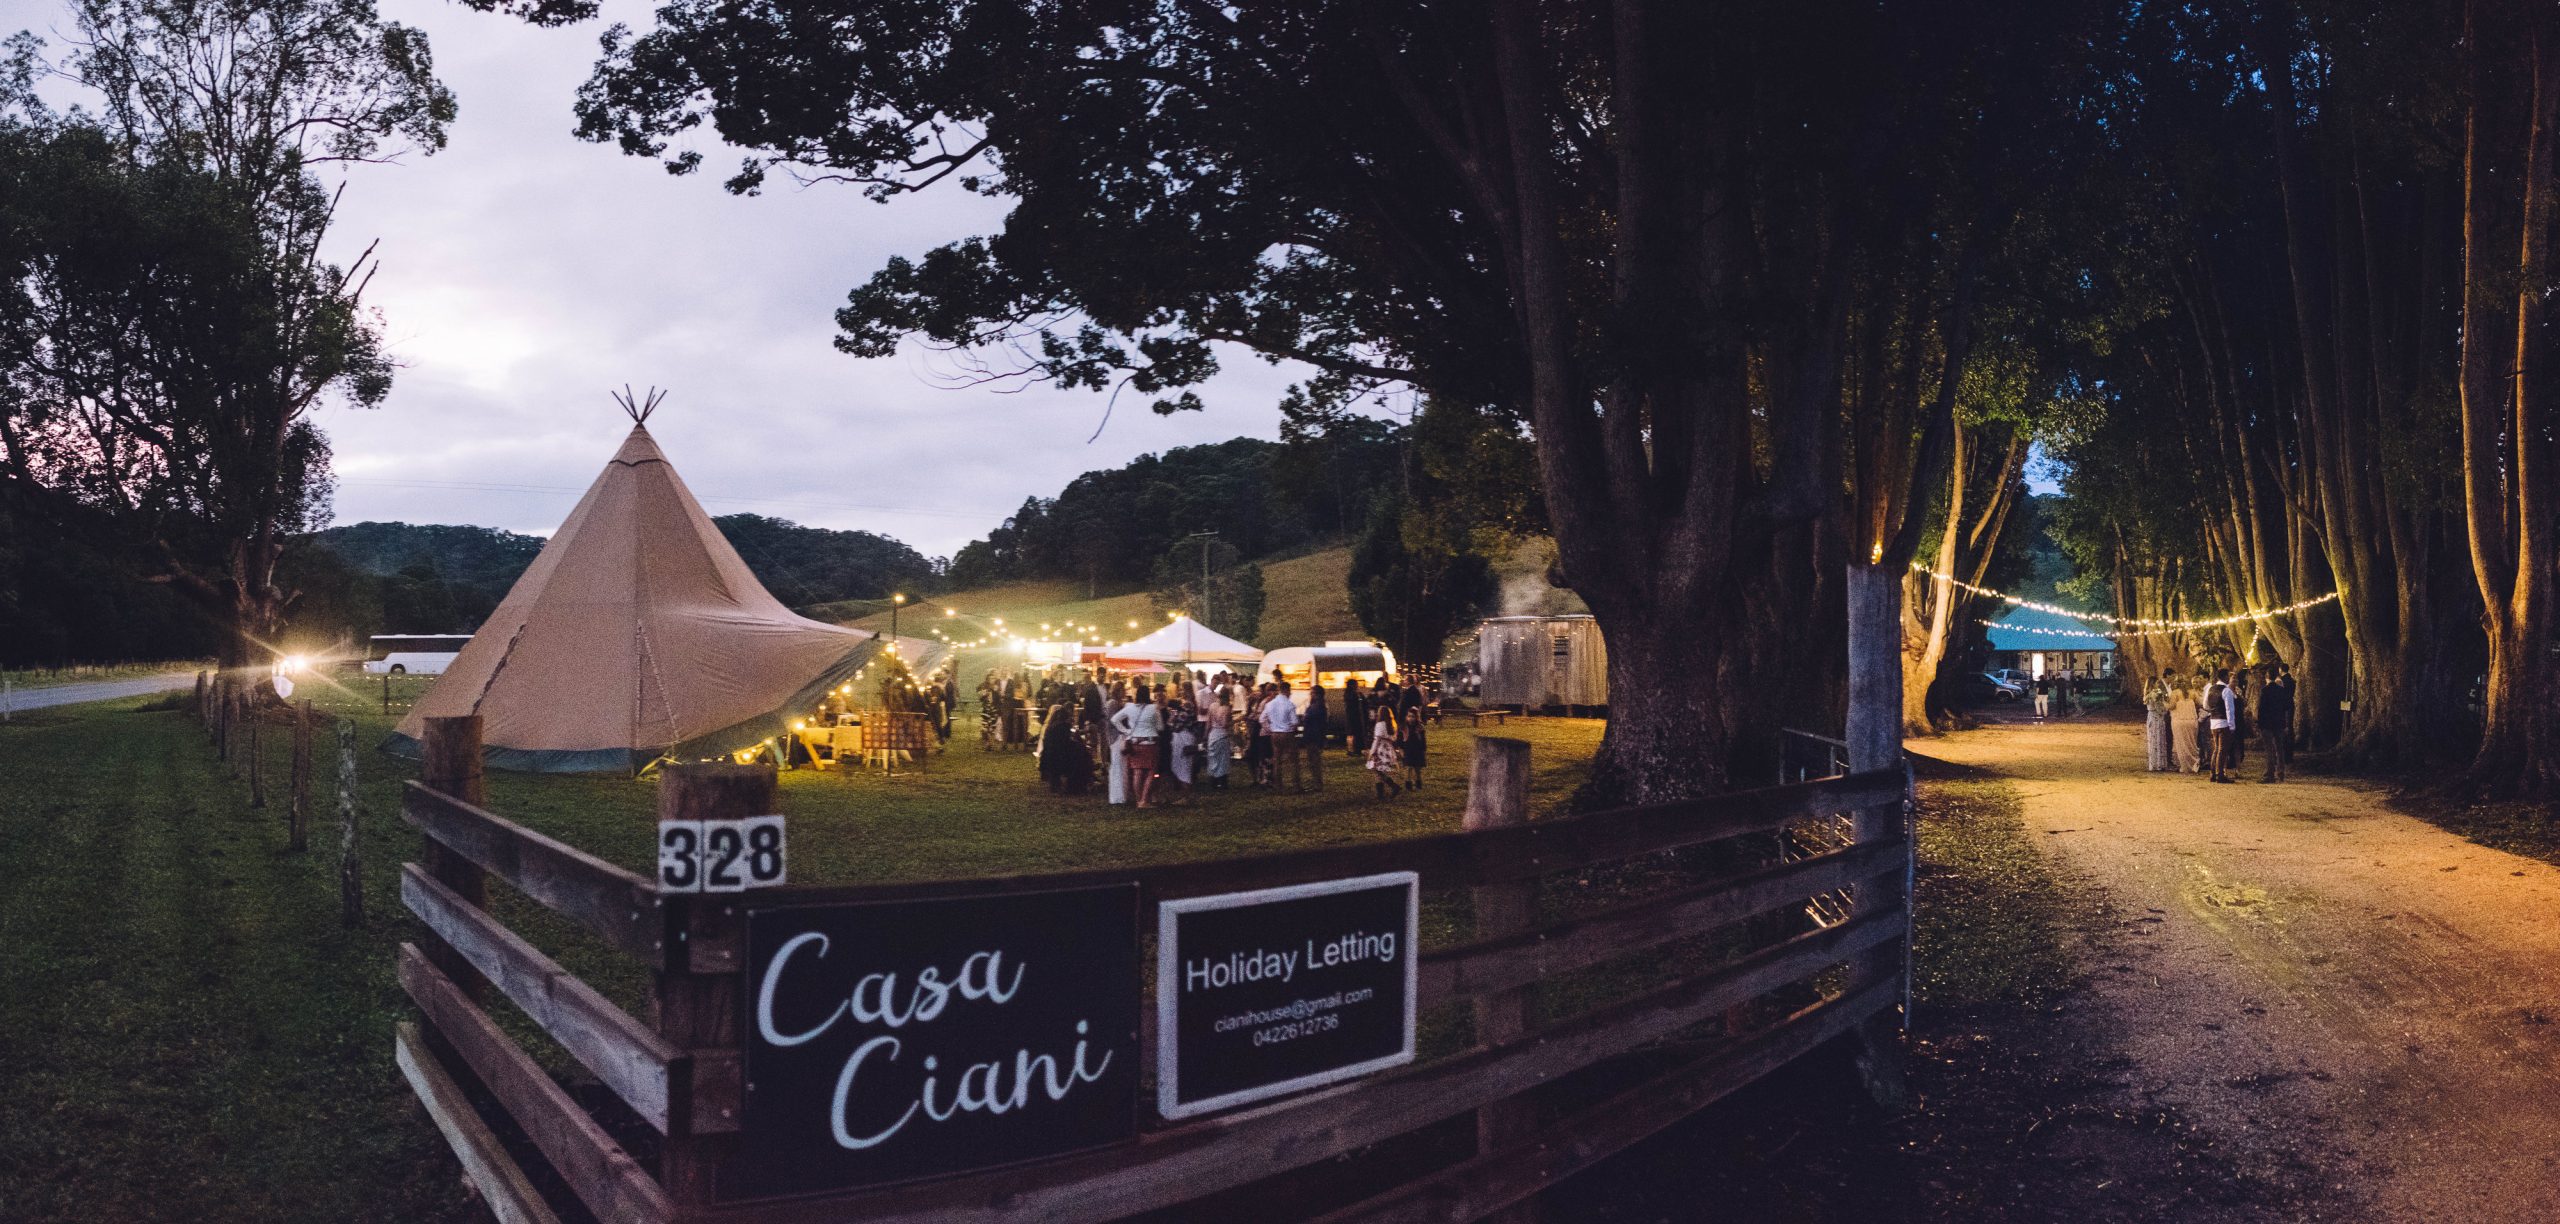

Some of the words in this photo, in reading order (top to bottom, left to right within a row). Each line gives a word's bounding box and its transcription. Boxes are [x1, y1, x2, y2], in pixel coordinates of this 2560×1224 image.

[663, 825, 781, 888] 328
[757, 931, 1025, 1047] Casa
[1186, 949, 1298, 993] Holiday
[1307, 931, 1396, 970] Letting
[1214, 987, 1373, 1032] cianihouse@gmail.com
[1252, 1013, 1339, 1046] 0422612736
[831, 1019, 1112, 1150] Ciani
